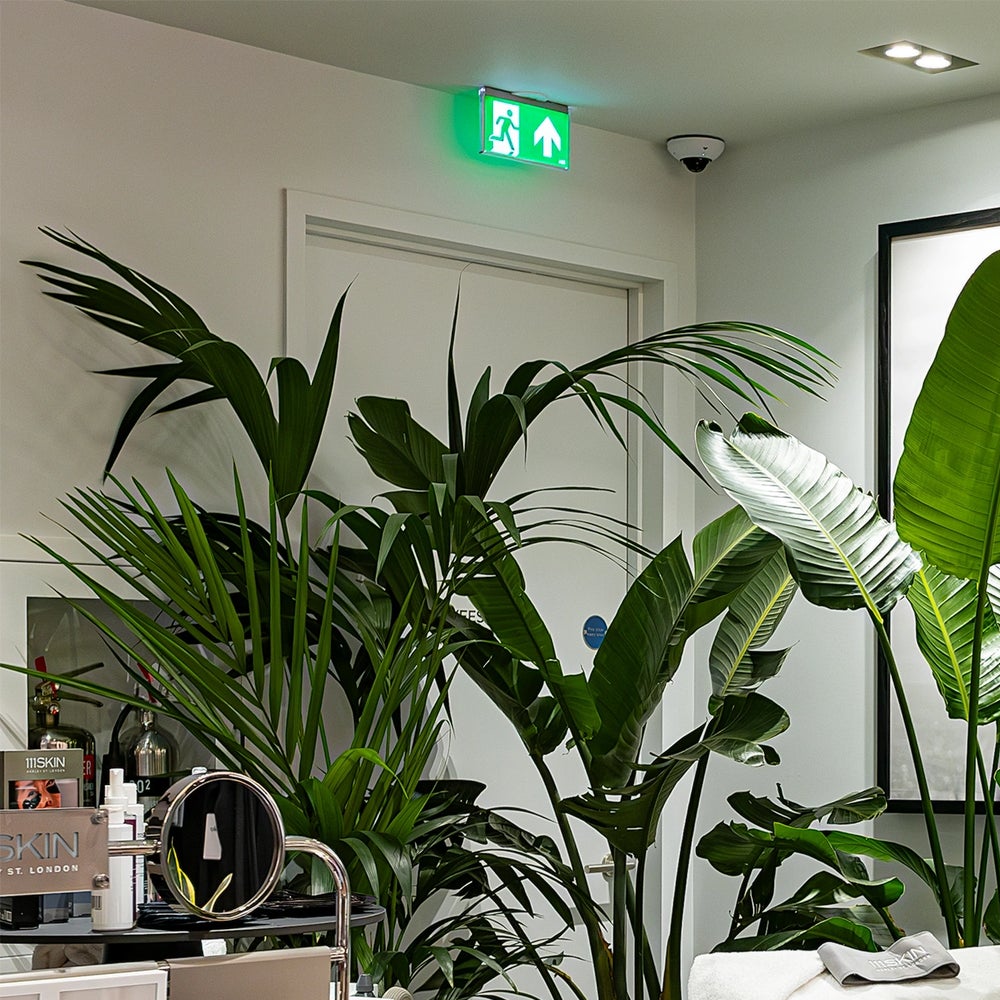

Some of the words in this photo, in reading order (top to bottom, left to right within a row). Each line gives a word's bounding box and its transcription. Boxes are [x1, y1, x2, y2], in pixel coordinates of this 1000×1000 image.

[25, 756, 66, 769] 111SKIN
[7, 867, 23, 875] ST.
[29, 864, 79, 875] LONDON
